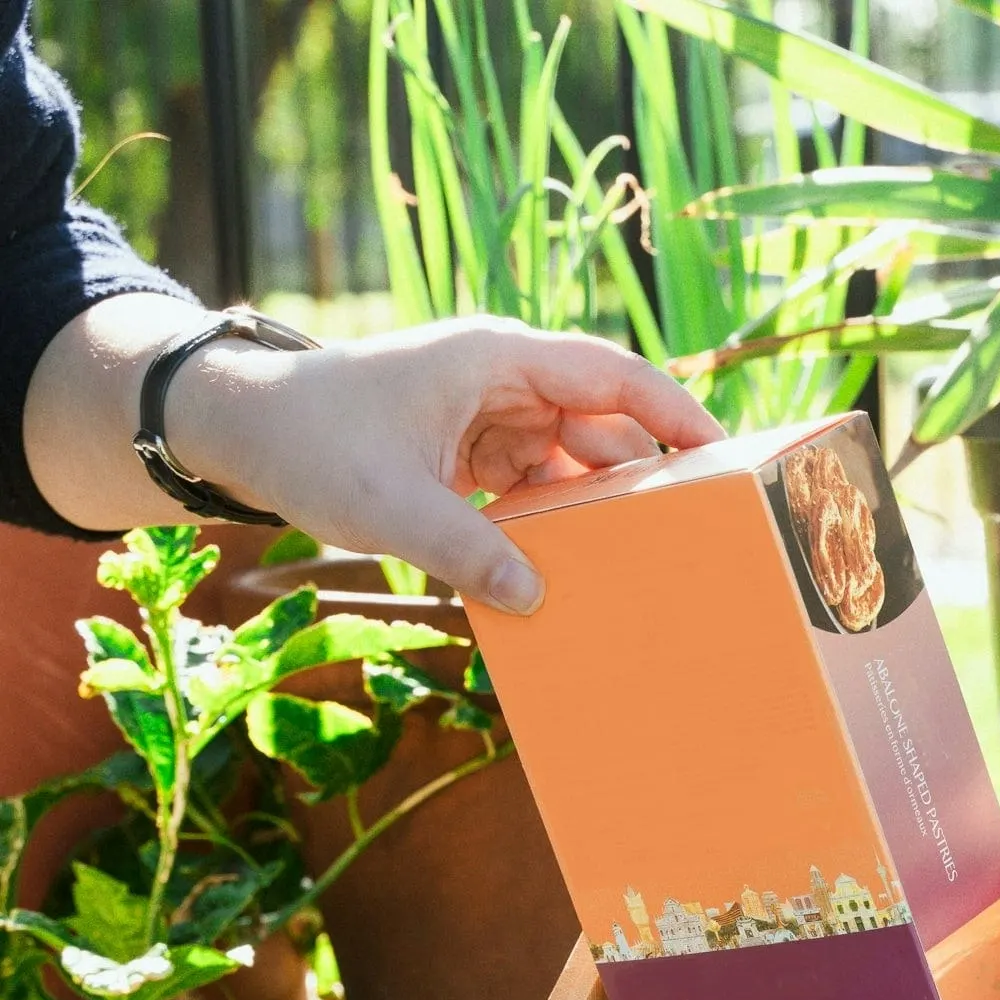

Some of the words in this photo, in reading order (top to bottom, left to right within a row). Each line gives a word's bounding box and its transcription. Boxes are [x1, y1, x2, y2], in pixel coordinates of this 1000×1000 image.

[885, 724, 894, 738] en
[874, 658, 908, 738] ABALONE
[903, 739, 932, 806] SHAPED
[926, 807, 958, 882] PASTRIES
[887, 738, 905, 777] forme
